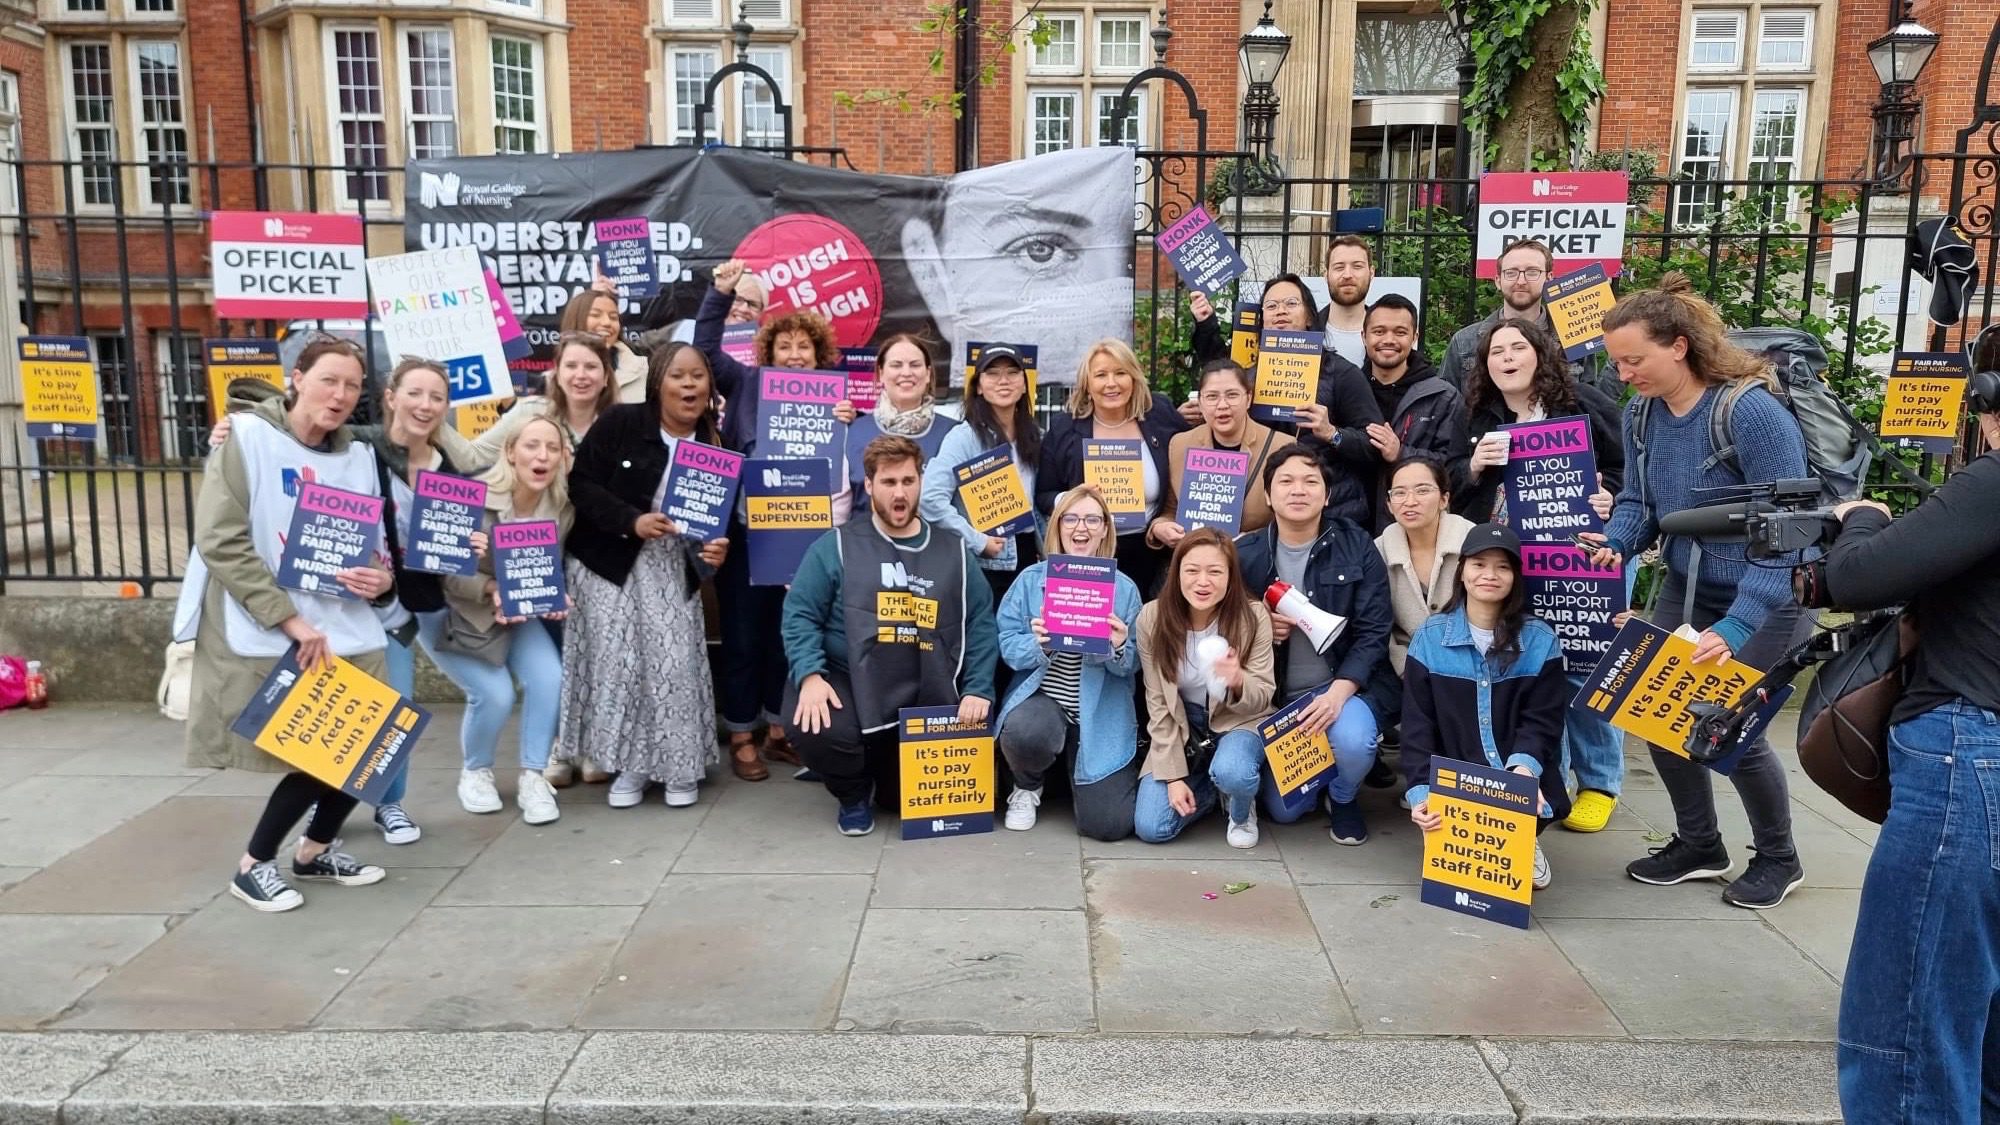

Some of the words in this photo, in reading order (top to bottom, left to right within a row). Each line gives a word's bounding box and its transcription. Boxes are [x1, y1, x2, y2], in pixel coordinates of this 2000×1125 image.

[462, 184, 490, 194] Royal
[491, 184, 526, 196] College
[462, 195, 473, 205] of
[475, 195, 512, 209] Nursing
[1489, 209, 1616, 229] OFFICIAL
[420, 221, 703, 250] UNDERSTAED.
[601, 224, 644, 237] HONK
[1164, 213, 1204, 248] HONK
[1179, 234, 1215, 265] SUPPORT
[1184, 255, 1205, 272] FAIR
[1203, 241, 1220, 257] PAY
[224, 249, 355, 270] OFFICIAL
[376, 249, 469, 276] PROTECT
[752, 239, 848, 291] NOUGH
[1199, 255, 1217, 272] FOR
[1194, 255, 1232, 286] NURSING
[240, 275, 341, 294] PICKET
[408, 271, 447, 290] OUR
[380, 286, 484, 315] PATIENTS
[787, 280, 817, 308] IS
[1577, 291, 1600, 303] time
[1581, 302, 1599, 314] pay
[394, 310, 485, 341] PROTECT
[426, 337, 464, 358] OUR
[1286, 358, 1310, 367] time
[448, 364, 482, 391] HS
[1285, 370, 1303, 379] pay
[769, 378, 838, 398] HONK
[1267, 380, 1305, 390] nursing
[1899, 383, 1917, 391] It's
[1921, 383, 1950, 392] time
[1260, 389, 1282, 397] staff
[1285, 391, 1311, 401] fairly
[1918, 396, 1941, 405] pay
[780, 403, 794, 414] IF
[796, 405, 824, 417] YOU
[1896, 406, 1943, 417] nursing
[769, 417, 835, 430] SUPPORT
[1886, 418, 1912, 426] staff
[1916, 418, 1949, 429] fairly
[769, 430, 802, 442] FAIR
[804, 432, 833, 443] PAY
[785, 443, 816, 455] FOR
[682, 448, 736, 473] HONK
[1191, 455, 1241, 470] HONK
[1525, 461, 1536, 472] IF
[1538, 457, 1570, 470] YOU
[987, 474, 1008, 486] time
[1199, 473, 1207, 481] IF
[1209, 474, 1230, 483] YOU
[1517, 470, 1584, 487] SUPPORT
[424, 479, 479, 500] HONK
[676, 476, 728, 497] SUPPORT
[991, 485, 1008, 498] pay
[1190, 482, 1237, 494] SUPPORT
[1519, 489, 1553, 501] FAIR
[1556, 485, 1585, 498] PAY
[308, 491, 376, 517] HONK
[674, 488, 700, 501] FAIR
[700, 494, 725, 507] PAY
[980, 493, 1015, 513] nursing
[1189, 492, 1212, 501] FAIR
[1214, 495, 1235, 504] PAY
[445, 502, 468, 515] YOU
[685, 500, 709, 513] FOR
[767, 502, 810, 510] PICKET
[1200, 502, 1221, 512] FOR
[1538, 502, 1569, 514] FOR
[316, 514, 328, 525] IF
[331, 517, 359, 532] YOU
[422, 509, 475, 526] SUPPORT
[668, 506, 720, 527] NURSING
[751, 513, 829, 523] SUPERVISOR
[1185, 510, 1232, 523] NURSING
[1522, 514, 1590, 530] NURSING
[421, 520, 449, 532] FAIR
[303, 523, 367, 545] SUPPORT
[433, 534, 458, 545] FOR
[500, 528, 552, 543] HONK
[301, 535, 333, 550] FAIR
[335, 542, 363, 556] PAY
[417, 541, 471, 558] NURSING
[523, 547, 544, 556] YOU
[314, 550, 343, 564] FOR
[504, 556, 554, 568] SUPPORT
[506, 568, 532, 579] FAIR
[534, 567, 554, 577] PAY
[520, 578, 543, 587] FOR
[1545, 581, 1557, 592] IF
[1562, 581, 1598, 593] YOU
[508, 586, 558, 600] NURSING
[886, 596, 909, 605] THE
[1533, 595, 1611, 608] SUPPORT
[880, 608, 896, 616] OF
[1578, 611, 1611, 623] PAY
[897, 627, 918, 635] FAIR
[1556, 624, 1590, 636] FOR
[1600, 667, 1619, 690] FAIR
[1615, 649, 1632, 670] PAY
[1610, 673, 1627, 693] FOR
[1625, 633, 1655, 676] NURSING
[1628, 694, 1652, 719] It's
[1649, 655, 1681, 693] time
[1652, 703, 1671, 719] to
[1669, 671, 1696, 705] pay
[298, 684, 348, 744] nursing
[345, 698, 361, 715] to
[361, 700, 383, 725] It's
[275, 703, 312, 746] fairly
[927, 724, 946, 733] FOR
[321, 718, 345, 749] pay
[334, 729, 364, 764] time
[391, 731, 407, 755] FAIR
[1276, 741, 1290, 753] It's
[1284, 752, 1293, 760] to
[1296, 739, 1312, 754] pay
[916, 748, 939, 759] It's
[943, 746, 978, 758] time
[1284, 746, 1319, 772] nursing
[354, 744, 386, 790] NURSING
[376, 753, 393, 776] PAY
[923, 765, 938, 774] to
[943, 763, 971, 775] pay
[1281, 770, 1303, 786] staff
[1304, 752, 1328, 770] fairly
[918, 776, 976, 790] nursing
[1460, 774, 1484, 786] FAIR
[1486, 779, 1506, 789] PAY
[909, 793, 943, 806] staff
[948, 791, 986, 804] fairly
[1460, 783, 1480, 793] FOR
[1482, 788, 1529, 804] NURSING
[1444, 804, 1470, 821] It's
[1475, 812, 1516, 832] time
[1451, 825, 1469, 838] to
[1474, 831, 1506, 850] pay
[1444, 842, 1511, 870] nursing
[1431, 857, 1472, 875] staff
[1476, 866, 1522, 890] fairly
